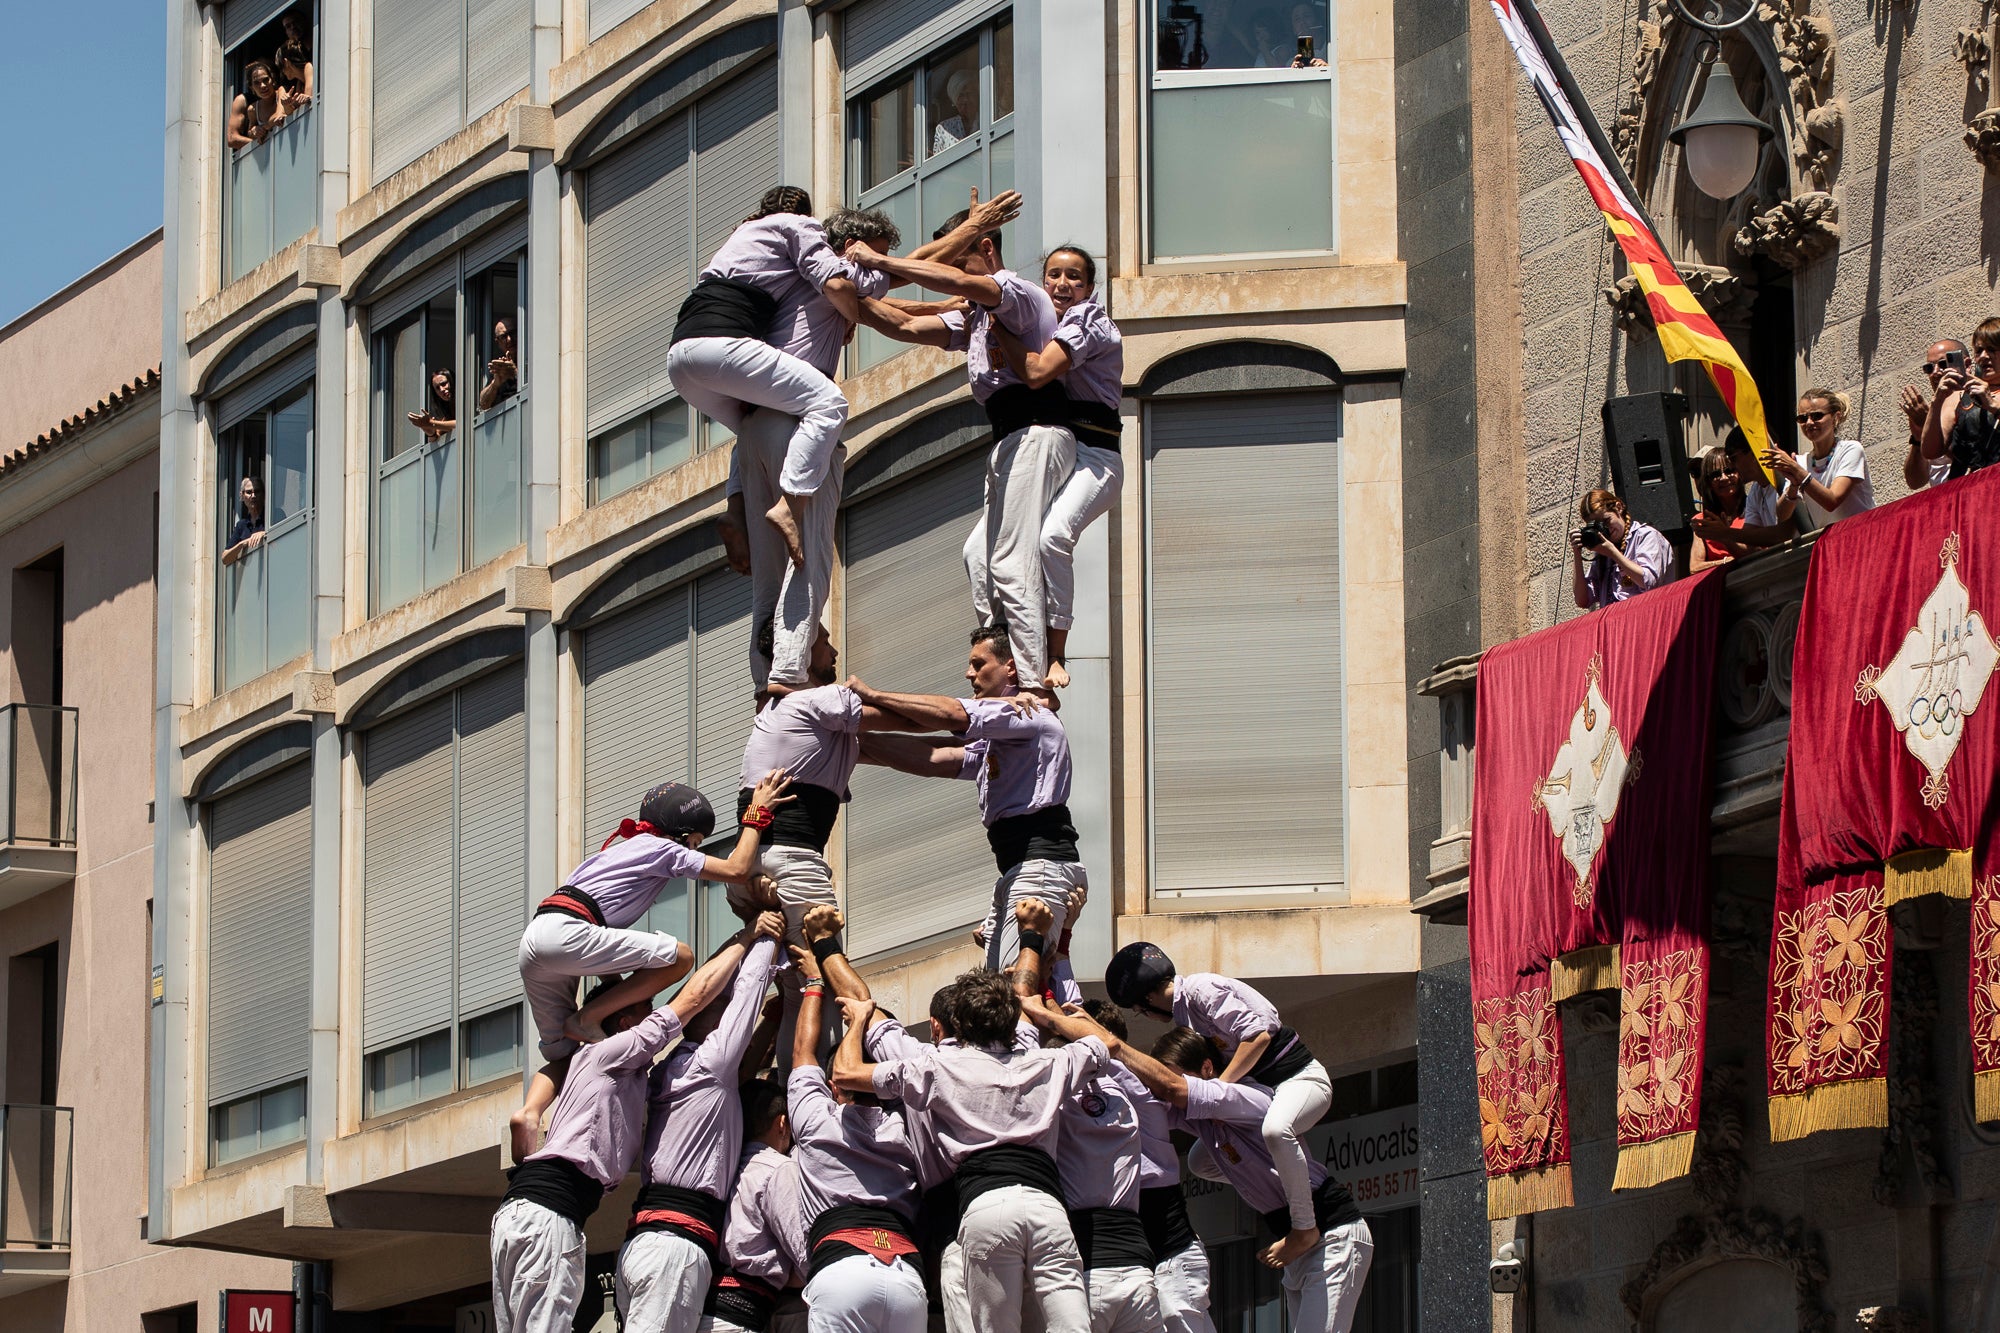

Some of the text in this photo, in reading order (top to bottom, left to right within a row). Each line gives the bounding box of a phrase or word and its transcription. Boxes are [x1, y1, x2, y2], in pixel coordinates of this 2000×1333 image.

[1325, 1121, 1418, 1170] Advocats
[1358, 1176, 1380, 1201] 595
[1385, 1172, 1399, 1196] 55
[1403, 1168, 1418, 1192] 77
[249, 1307, 273, 1333] M
